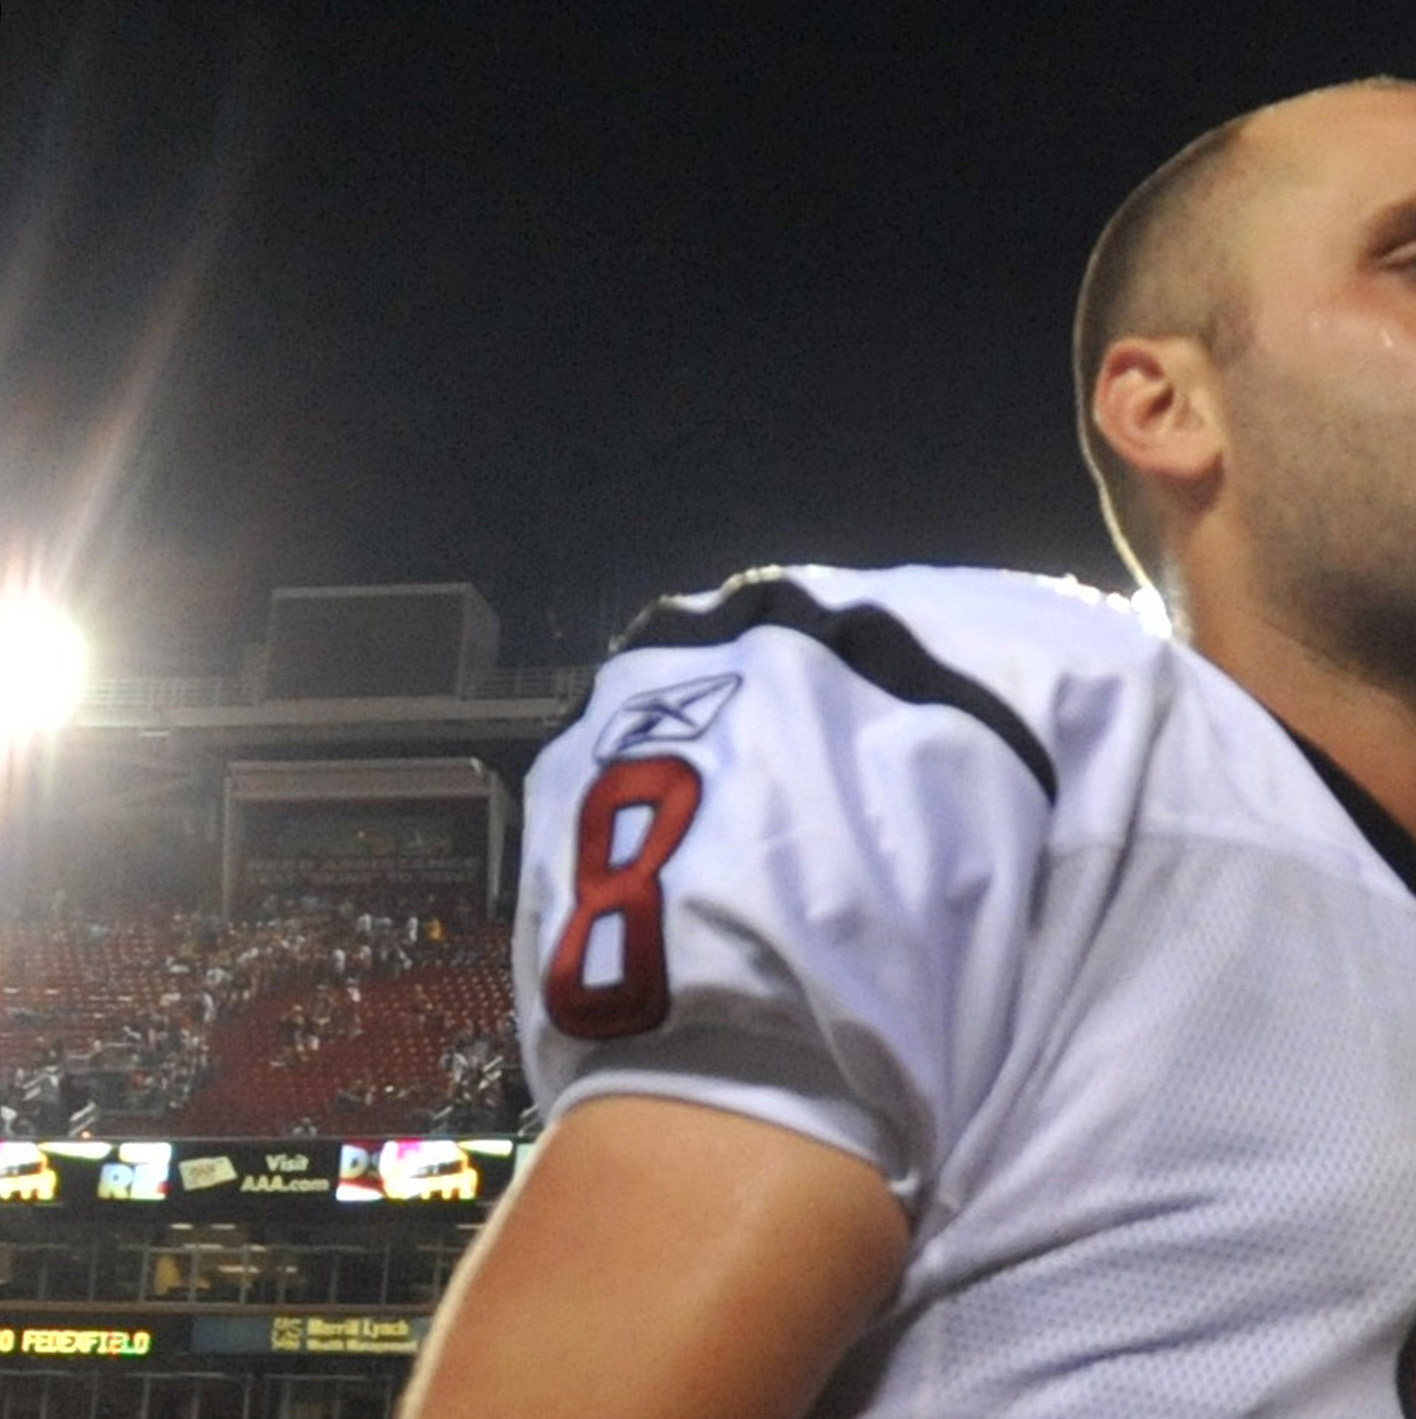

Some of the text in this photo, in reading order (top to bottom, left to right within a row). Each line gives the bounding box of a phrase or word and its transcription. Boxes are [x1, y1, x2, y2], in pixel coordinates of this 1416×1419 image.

[544, 755, 703, 1039] 8
[266, 1154, 309, 1172] Visit
[241, 1175, 330, 1192] AAA.com
